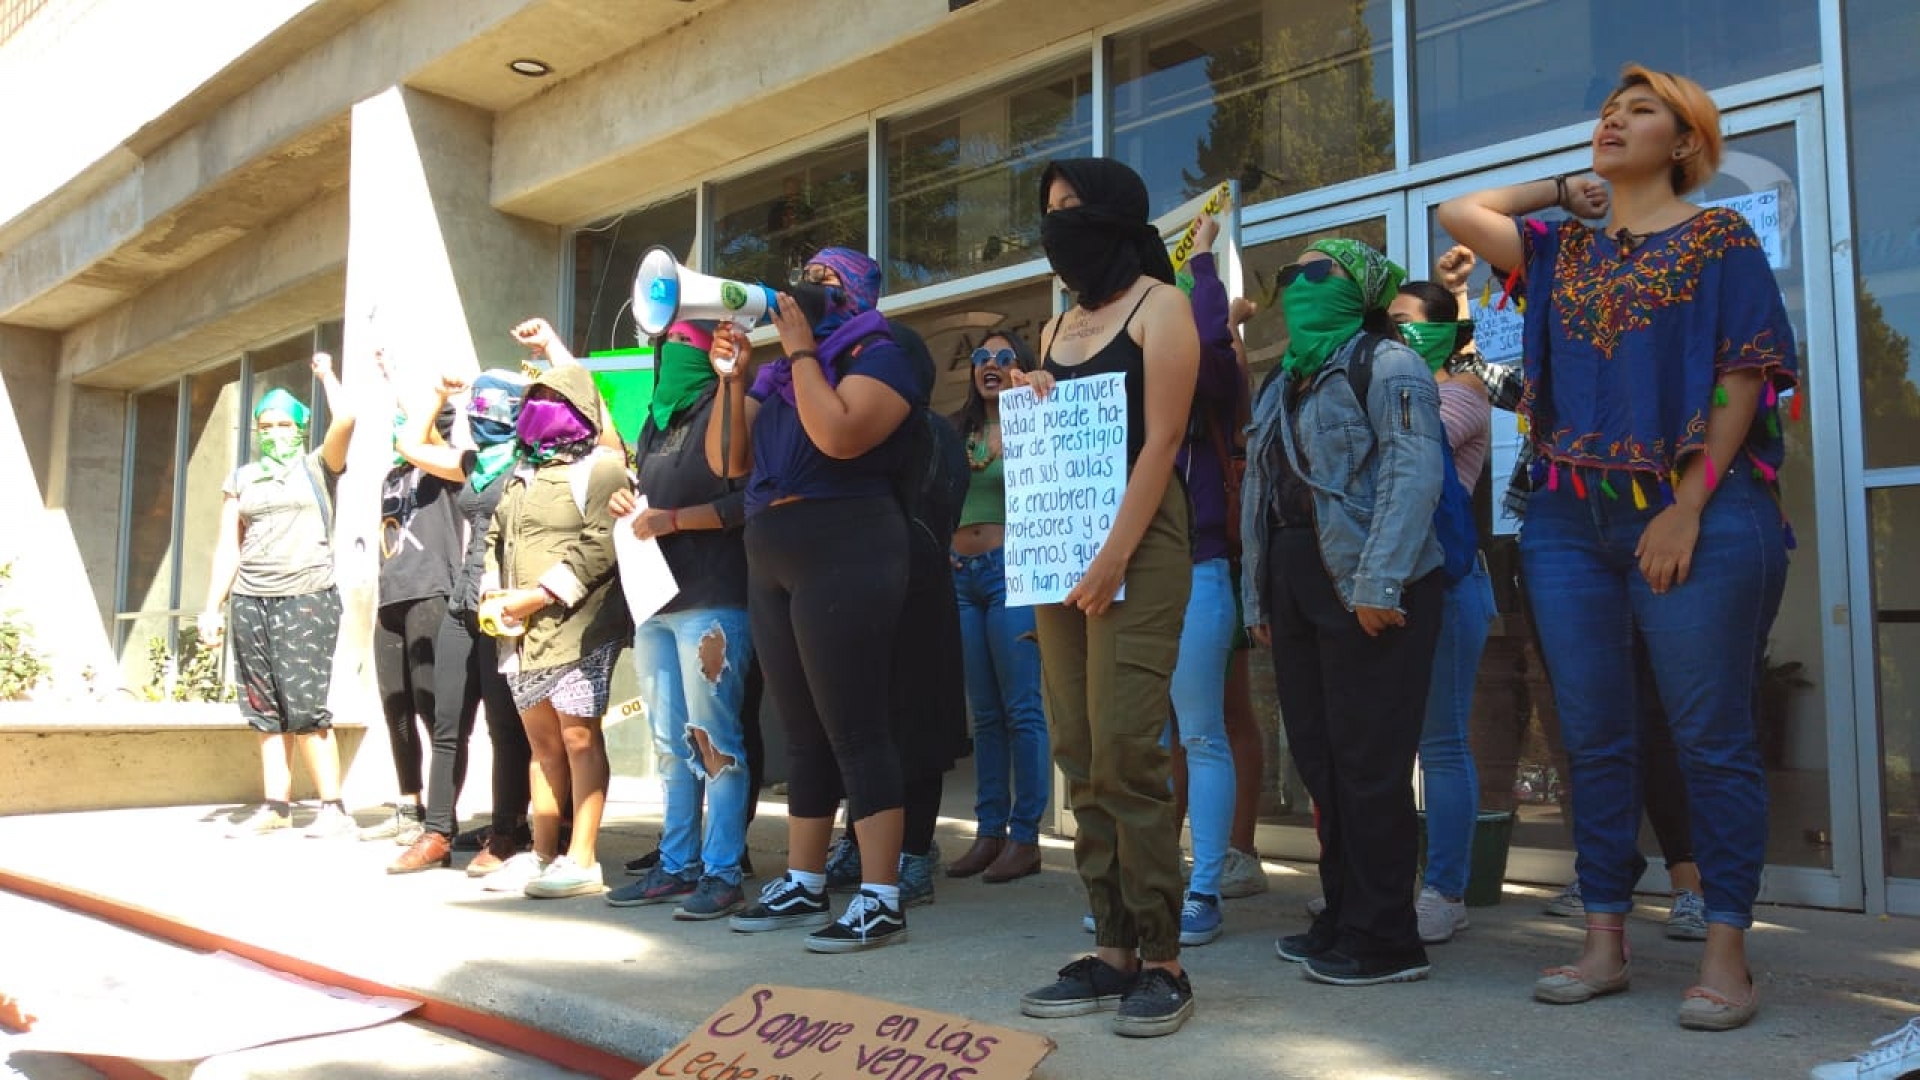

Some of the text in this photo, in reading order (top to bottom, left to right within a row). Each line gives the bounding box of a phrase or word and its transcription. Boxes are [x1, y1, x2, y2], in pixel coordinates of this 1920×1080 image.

[1001, 401, 1124, 437] sidad puede ha-
[1029, 436, 1046, 457] de
[1052, 424, 1123, 458] prestigio
[1019, 465, 1034, 487] en
[1040, 461, 1058, 484] sus
[1065, 454, 1114, 479] aulas
[1007, 485, 1116, 514] se encubren a
[1006, 513, 1110, 542] profesores y a
[1006, 541, 1067, 567] alumnos
[1006, 573, 1024, 594] nos
[1031, 570, 1060, 592] han
[707, 989, 855, 1059] Sangre
[875, 1014, 919, 1043] en
